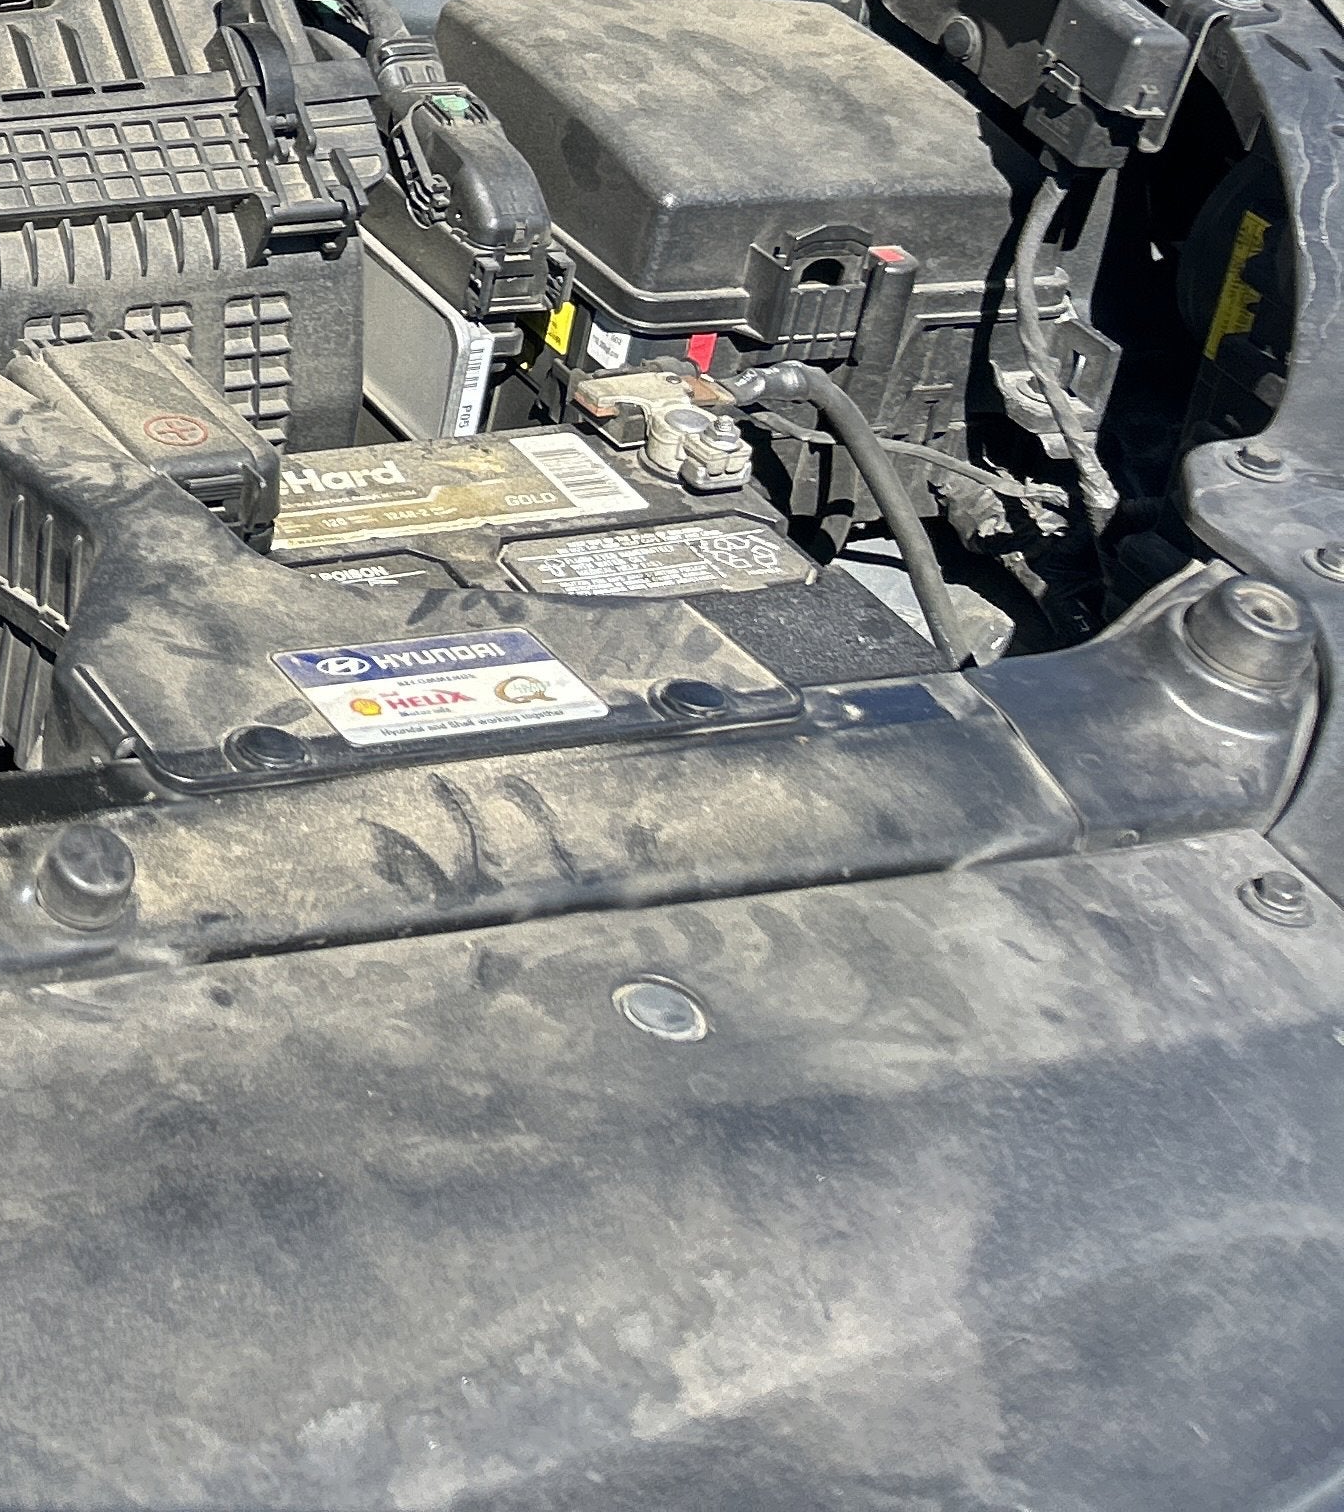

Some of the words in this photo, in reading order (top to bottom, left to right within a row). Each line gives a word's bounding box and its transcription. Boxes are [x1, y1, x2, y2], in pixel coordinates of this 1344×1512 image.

[504, 492, 557, 507] GOLD
[319, 565, 390, 582] POISON
[371, 641, 507, 671] HYUNDAI
[384, 690, 470, 710] HELIX
